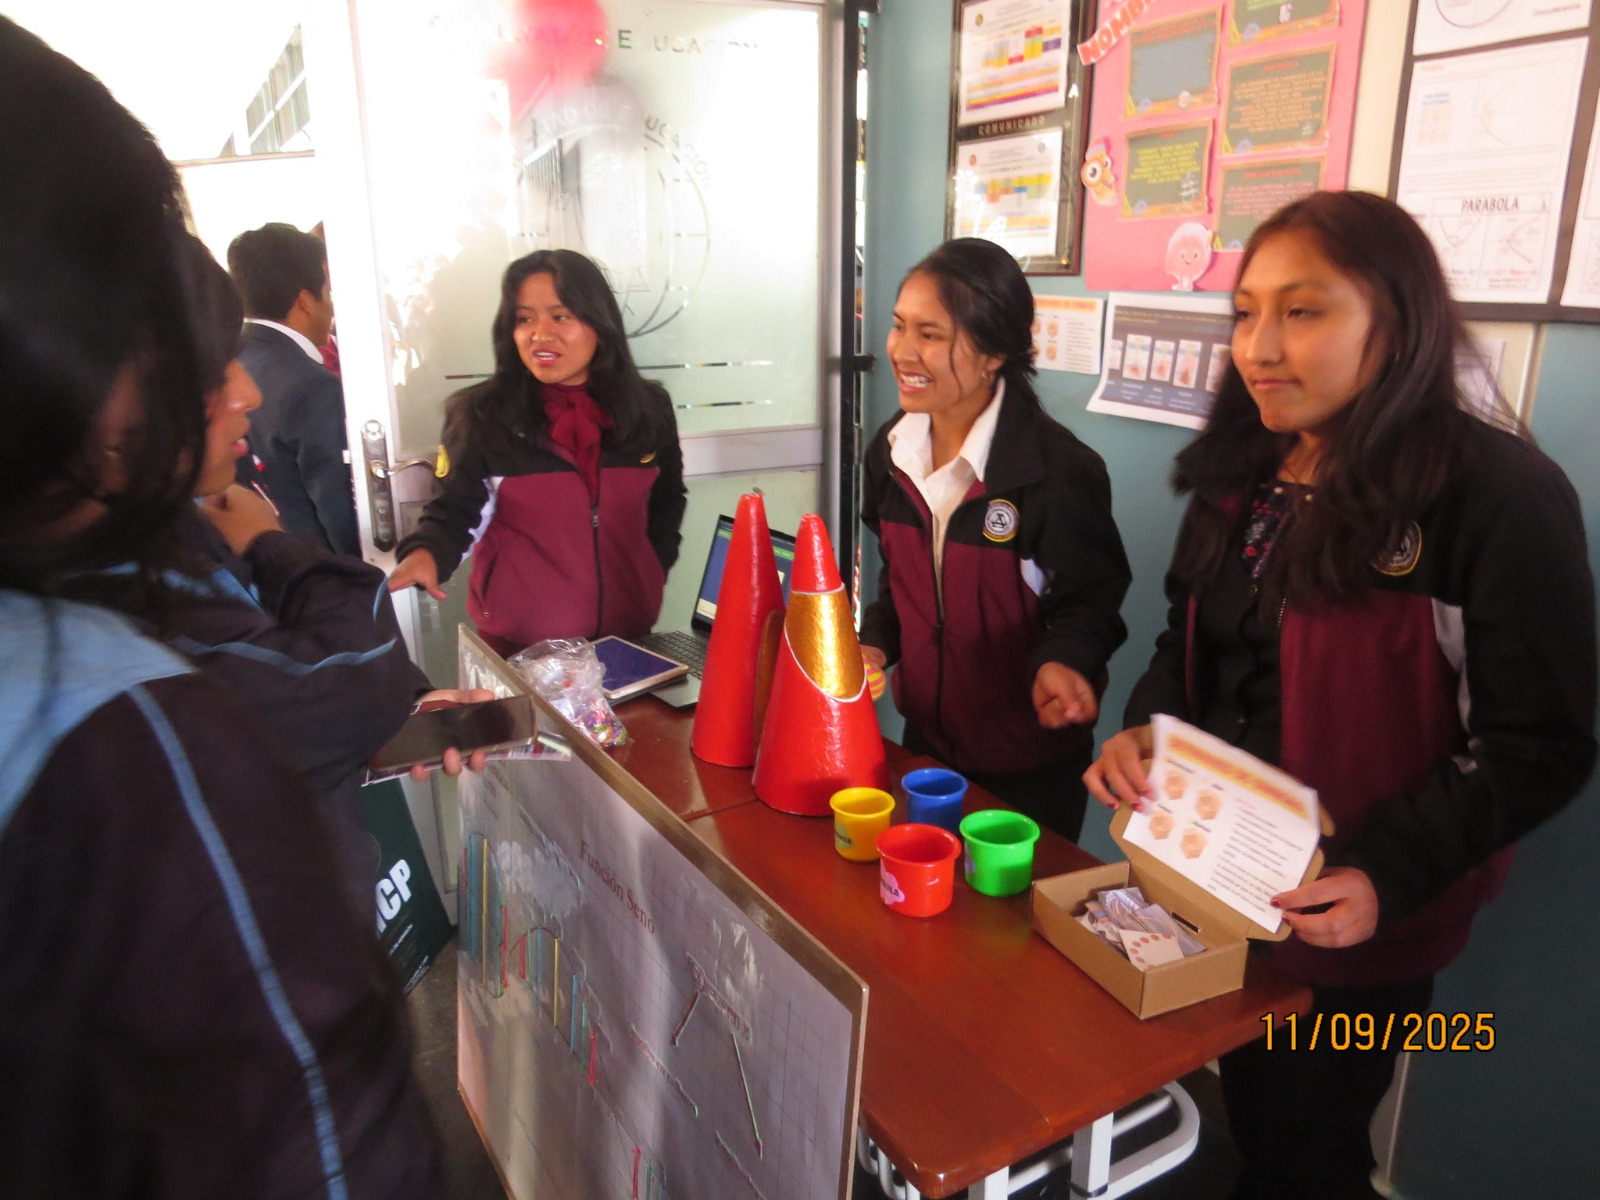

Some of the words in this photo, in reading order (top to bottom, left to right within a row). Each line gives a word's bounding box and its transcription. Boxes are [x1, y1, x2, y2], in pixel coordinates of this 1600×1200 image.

[978, 114, 1046, 137] COMUNICADO
[1460, 195, 1520, 215] PARABOLA
[580, 840, 624, 901] Función
[627, 888, 656, 934] Seno
